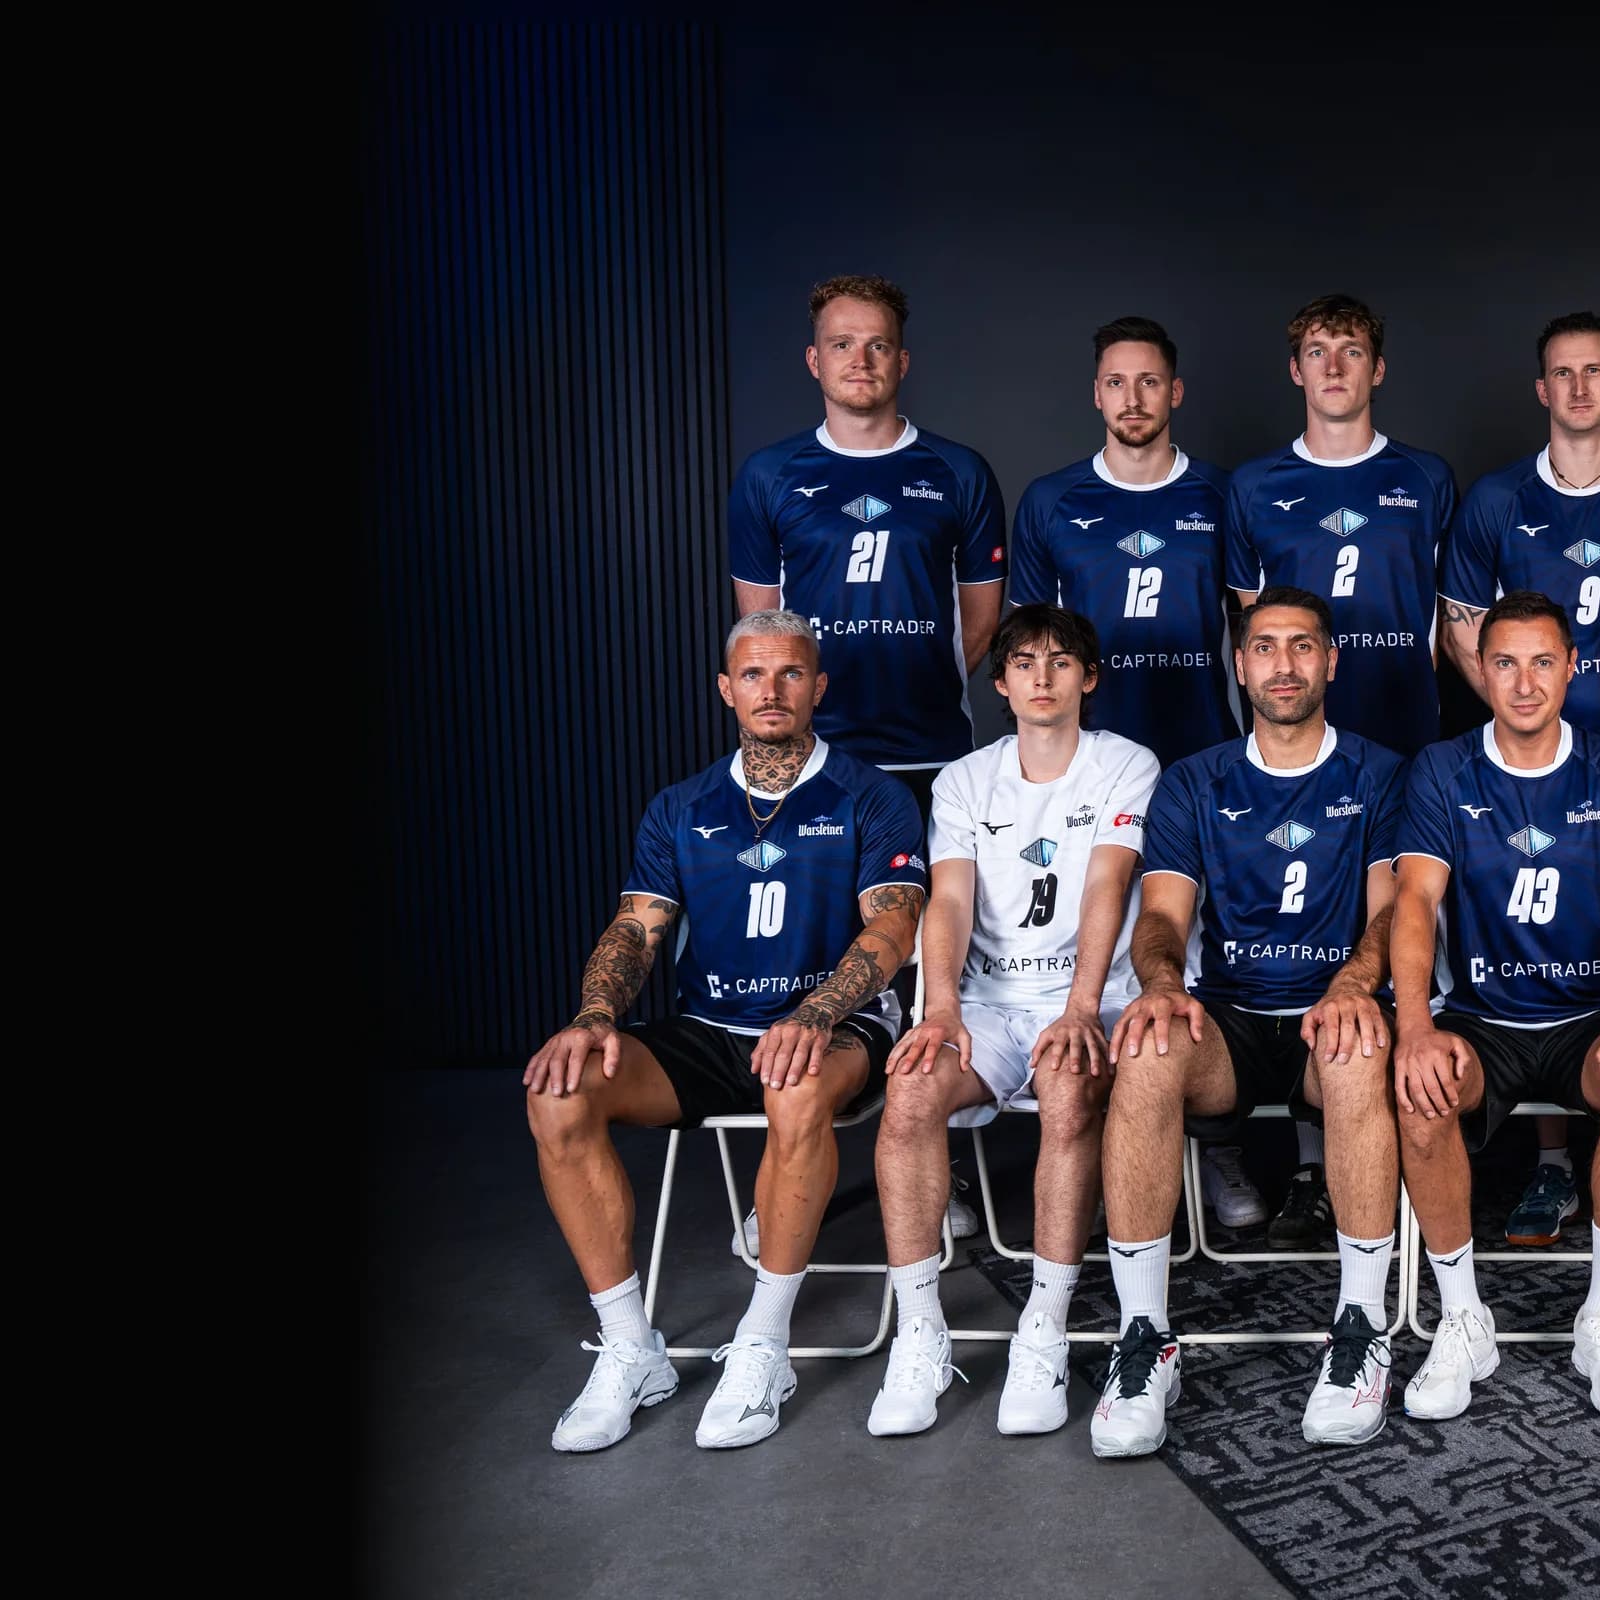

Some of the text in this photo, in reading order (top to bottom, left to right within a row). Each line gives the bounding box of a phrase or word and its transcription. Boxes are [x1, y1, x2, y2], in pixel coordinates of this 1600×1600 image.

[1379, 495, 1418, 507] Warsteiner
[846, 531, 889, 582] 21
[1332, 545, 1359, 597] 2
[1124, 567, 1162, 617] 12
[1576, 576, 1600, 625] 9
[834, 620, 935, 634] CAPTRADER
[799, 822, 844, 836] Warsteiner
[746, 881, 786, 938] 10
[1019, 873, 1057, 928] 19
[1279, 861, 1307, 913] 2
[1507, 867, 1560, 924] 43
[999, 955, 1077, 972] CAPTRA
[1250, 944, 1352, 962] CAPTRADE
[736, 972, 834, 993] CAPTRADE
